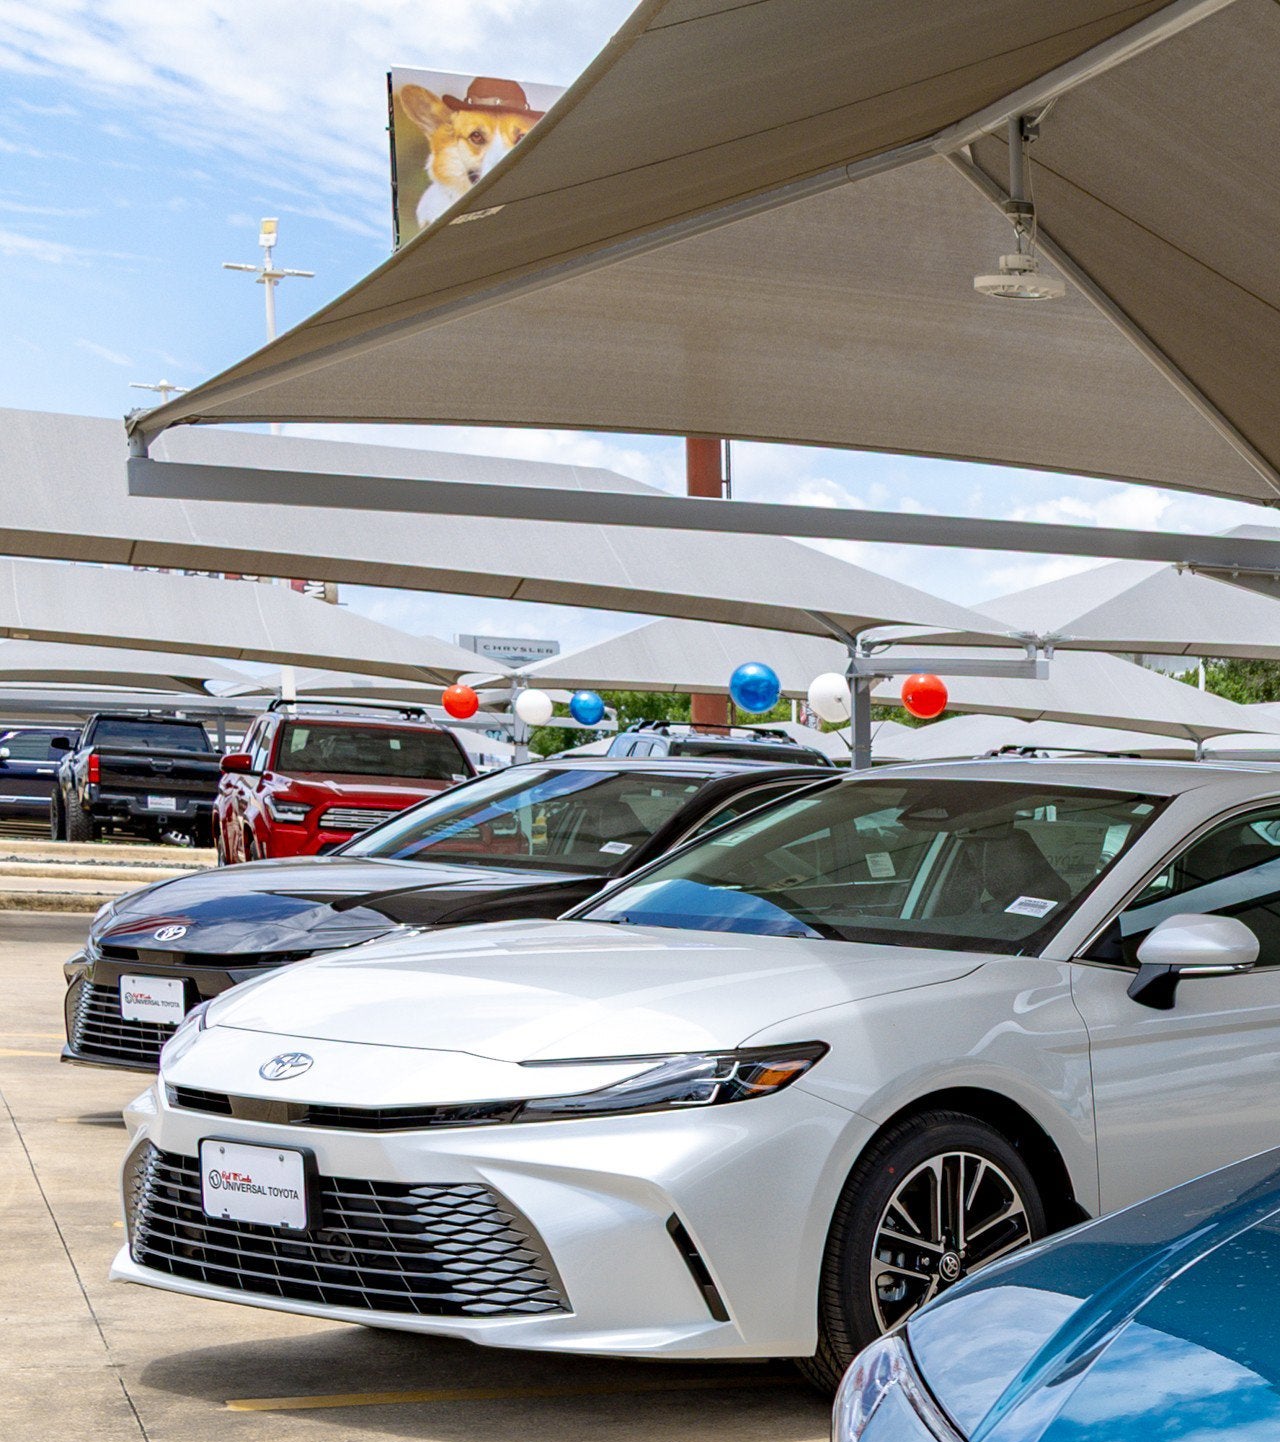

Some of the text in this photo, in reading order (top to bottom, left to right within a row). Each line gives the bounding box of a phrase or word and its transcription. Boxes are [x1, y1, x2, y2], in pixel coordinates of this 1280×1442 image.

[483, 645, 553, 654] CHRYSLER
[132, 999, 161, 1007] UNIVERSAL
[222, 1181, 300, 1200] UNIVERSAL TOYOTA
